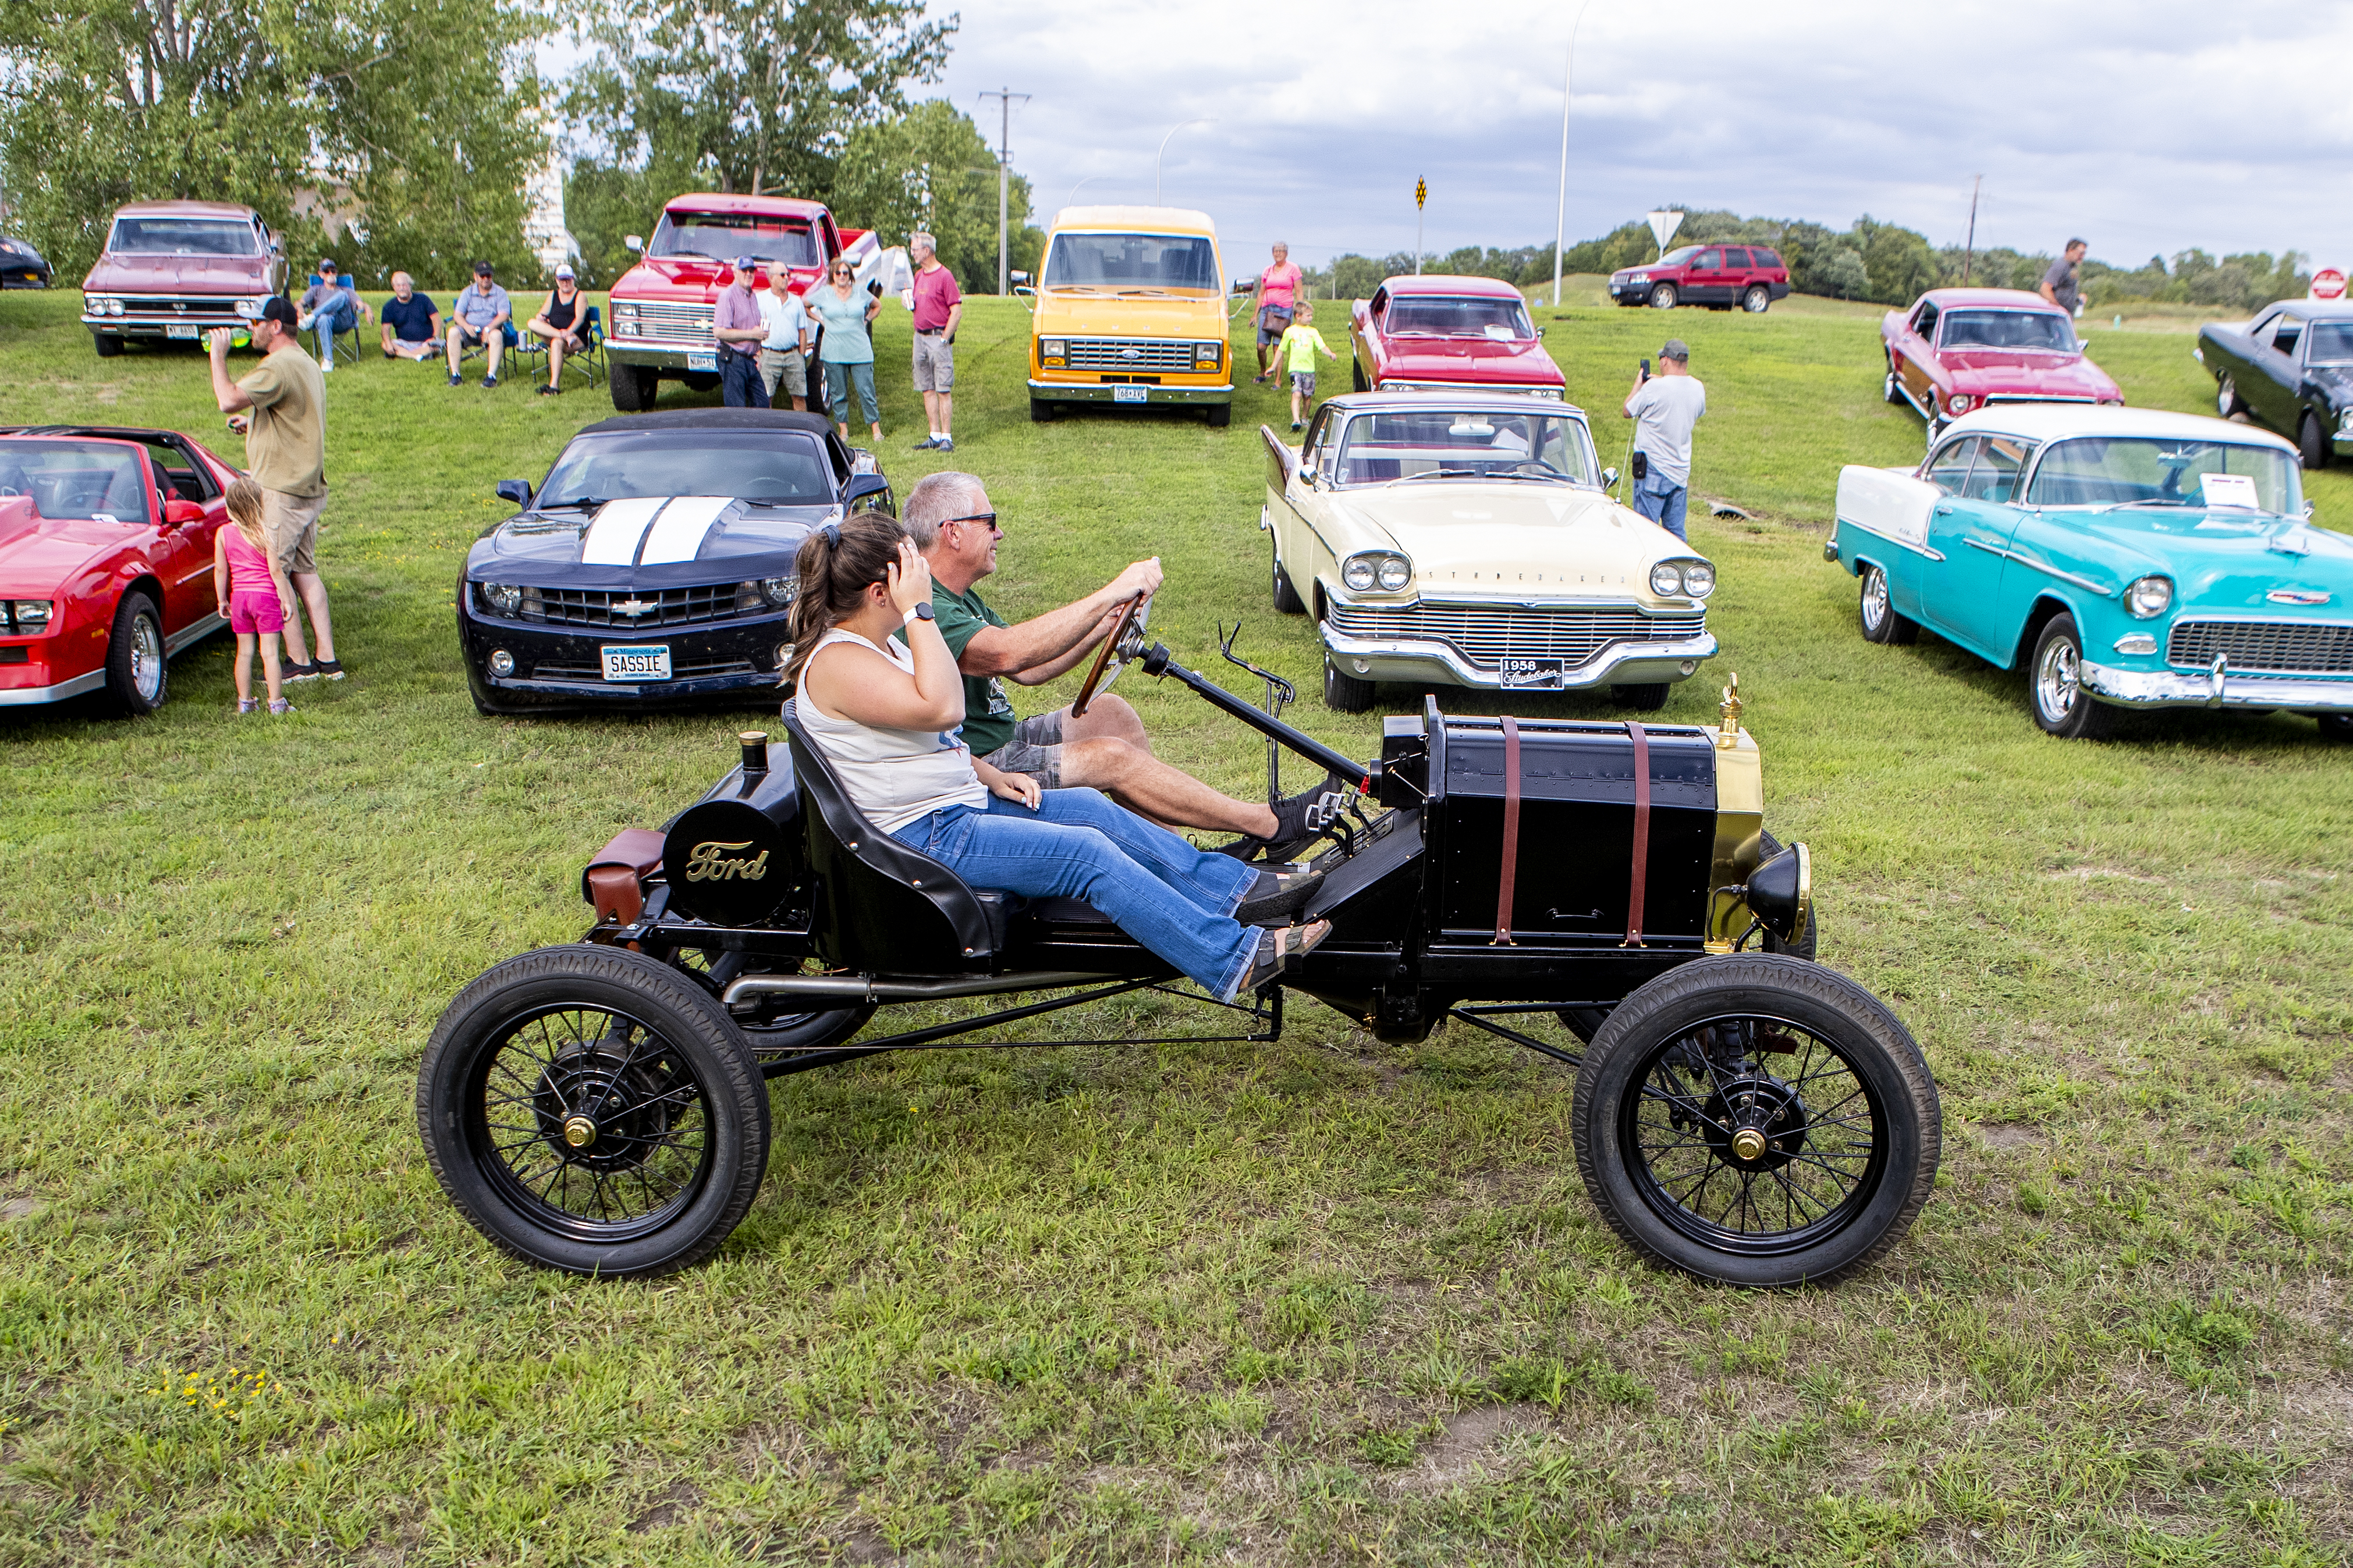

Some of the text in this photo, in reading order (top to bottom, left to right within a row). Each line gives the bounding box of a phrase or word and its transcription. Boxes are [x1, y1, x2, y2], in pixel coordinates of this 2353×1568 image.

[611, 655, 662, 673] SASSIE
[1503, 660, 1536, 671] 1958
[1503, 669, 1562, 684] Studebaker
[686, 841, 769, 882] Ford
